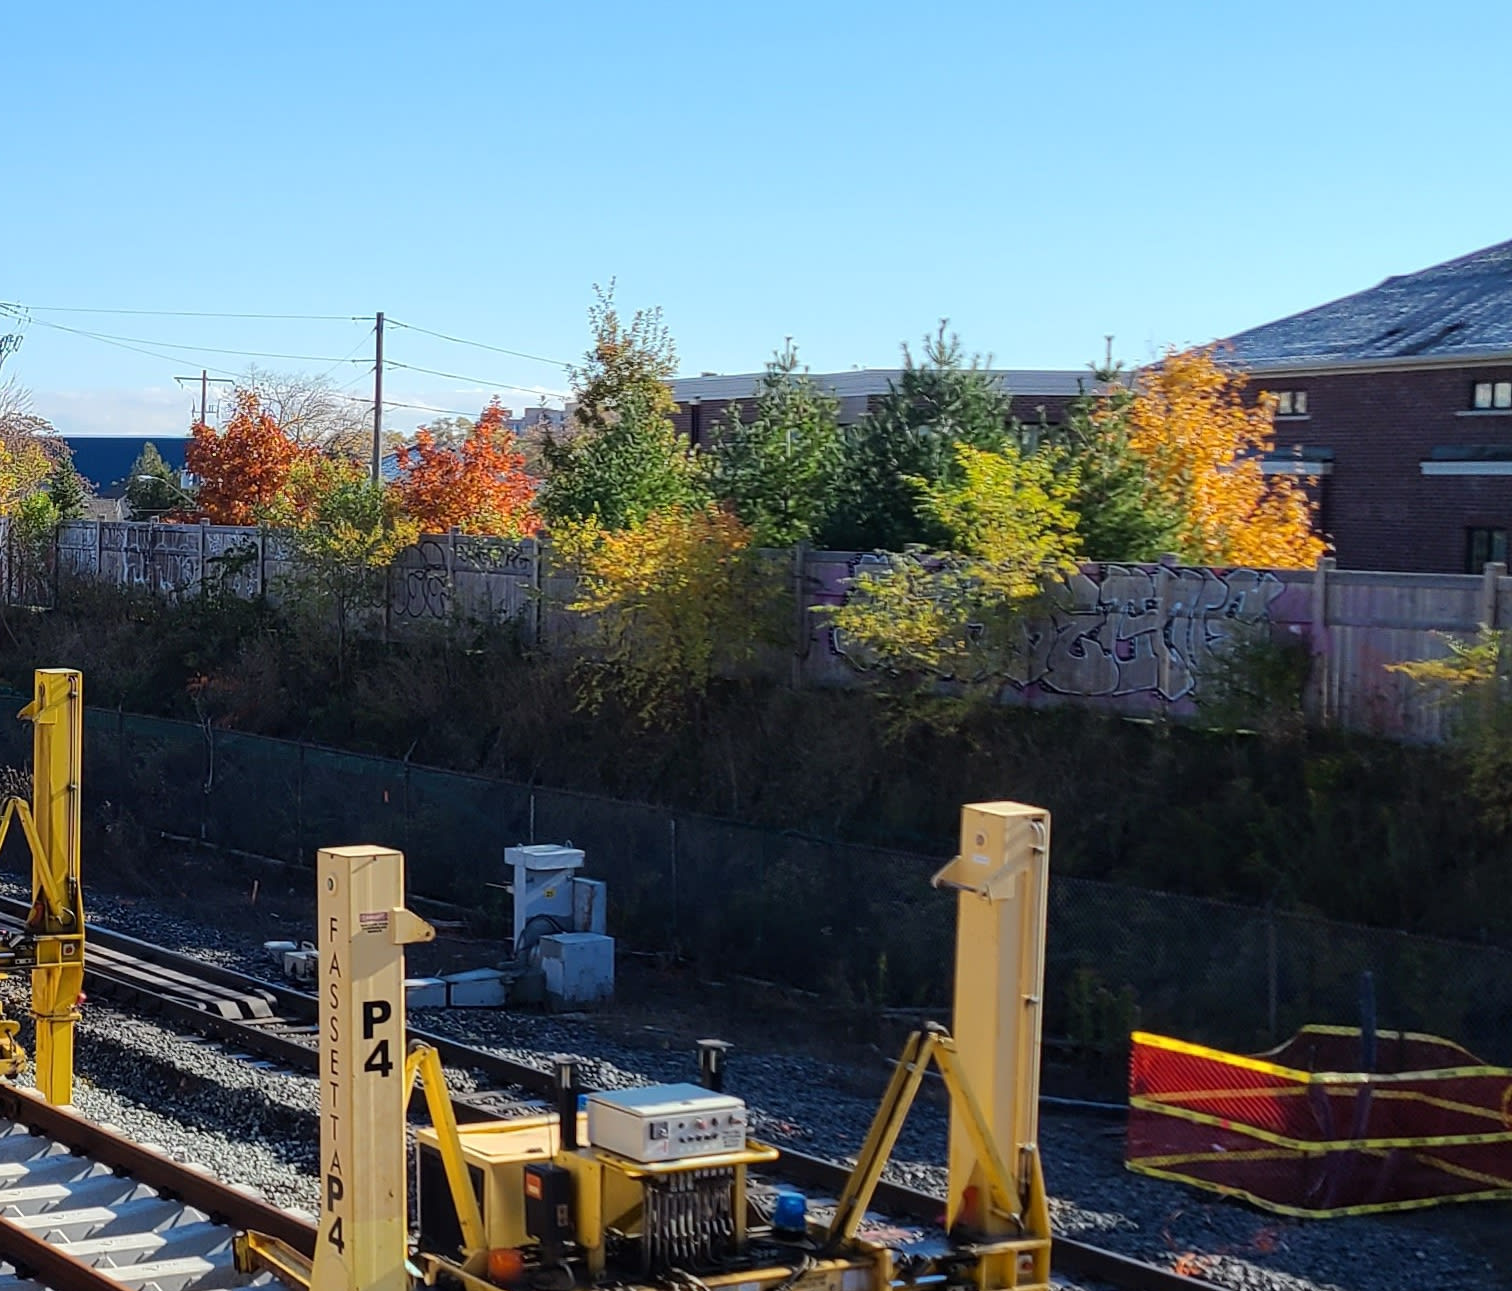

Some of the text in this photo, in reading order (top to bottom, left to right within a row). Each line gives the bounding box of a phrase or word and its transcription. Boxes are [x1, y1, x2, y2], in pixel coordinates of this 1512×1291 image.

[327, 917, 345, 1255] FASSETTA P4
[362, 1000, 394, 1078] P4
